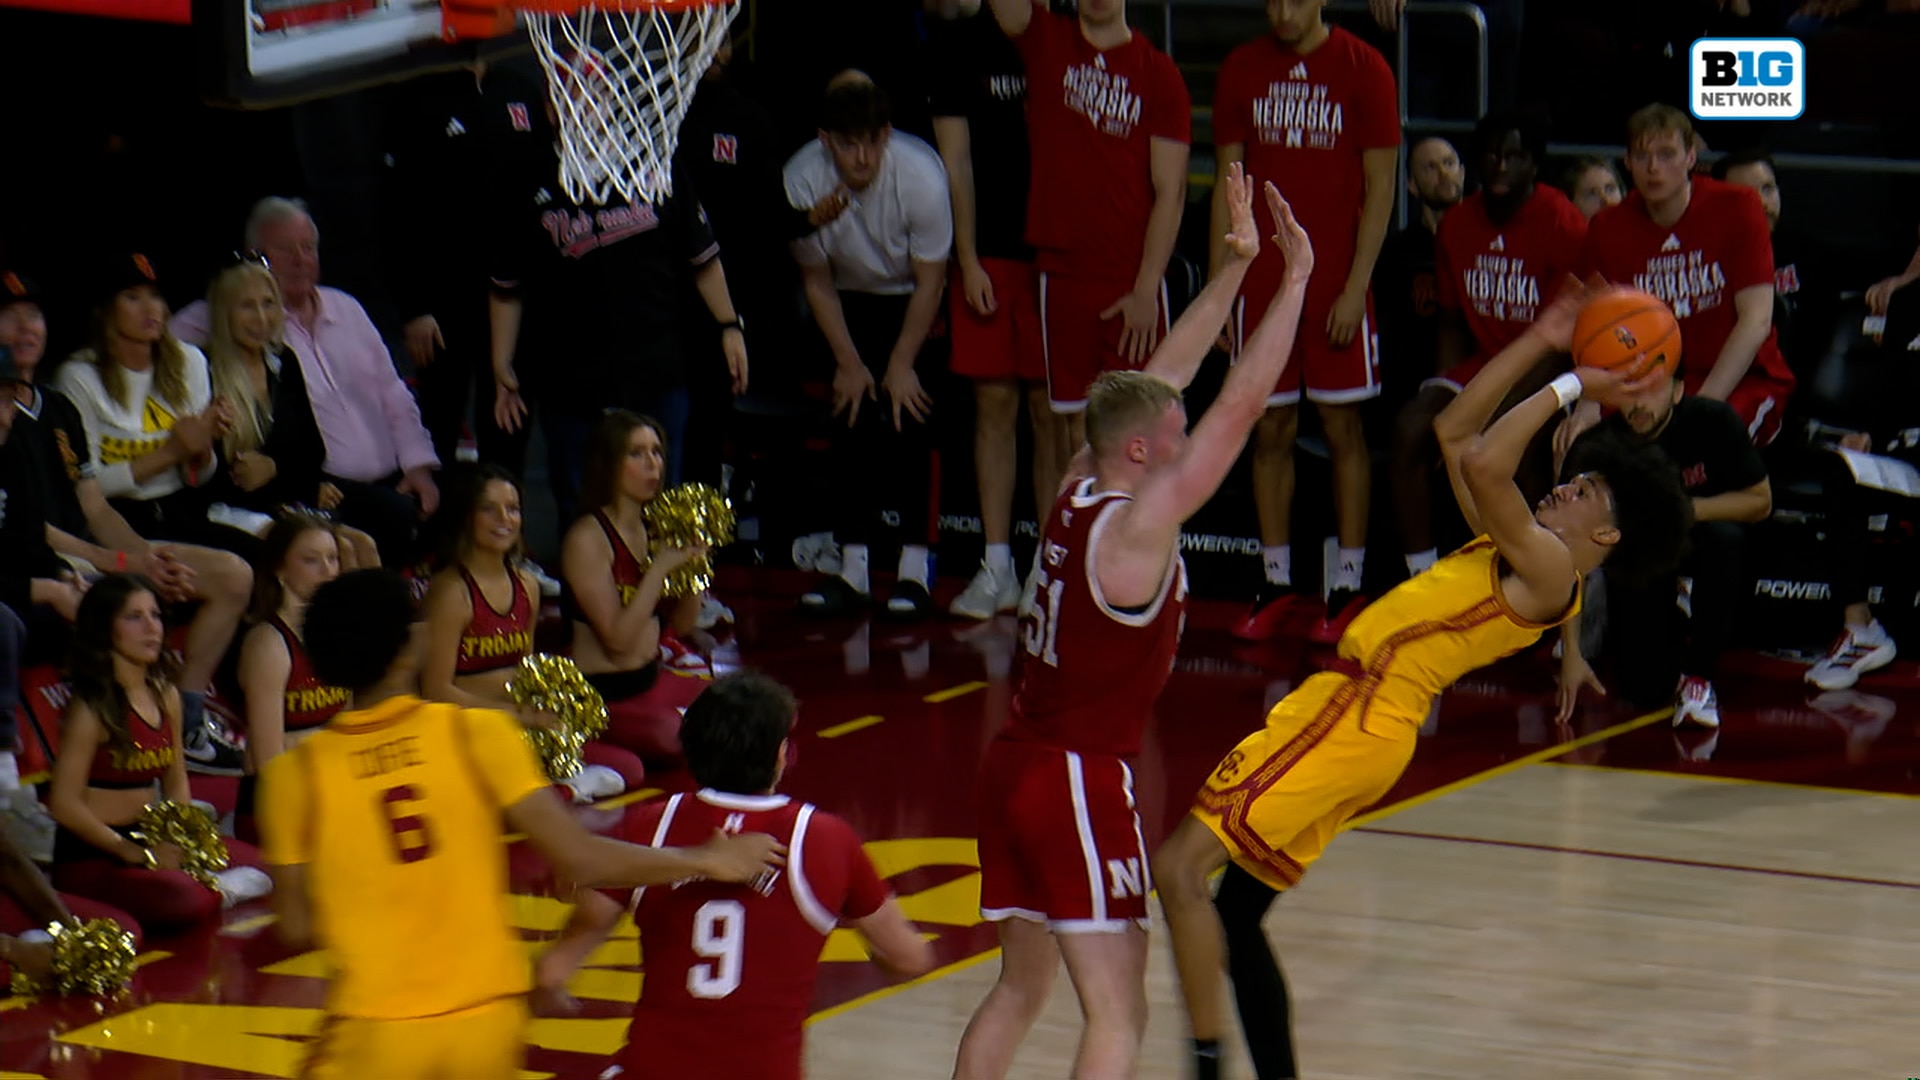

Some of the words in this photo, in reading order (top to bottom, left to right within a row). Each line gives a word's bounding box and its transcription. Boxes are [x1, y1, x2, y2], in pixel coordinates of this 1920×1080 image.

[507, 102, 532, 132] N
[1253, 97, 1343, 135] NEBRASKA
[712, 132, 738, 165] N
[1285, 127, 1303, 149] N
[1024, 565, 1066, 669] 51
[383, 784, 431, 864] 6
[1106, 856, 1144, 900] N
[685, 898, 747, 1000] 9
